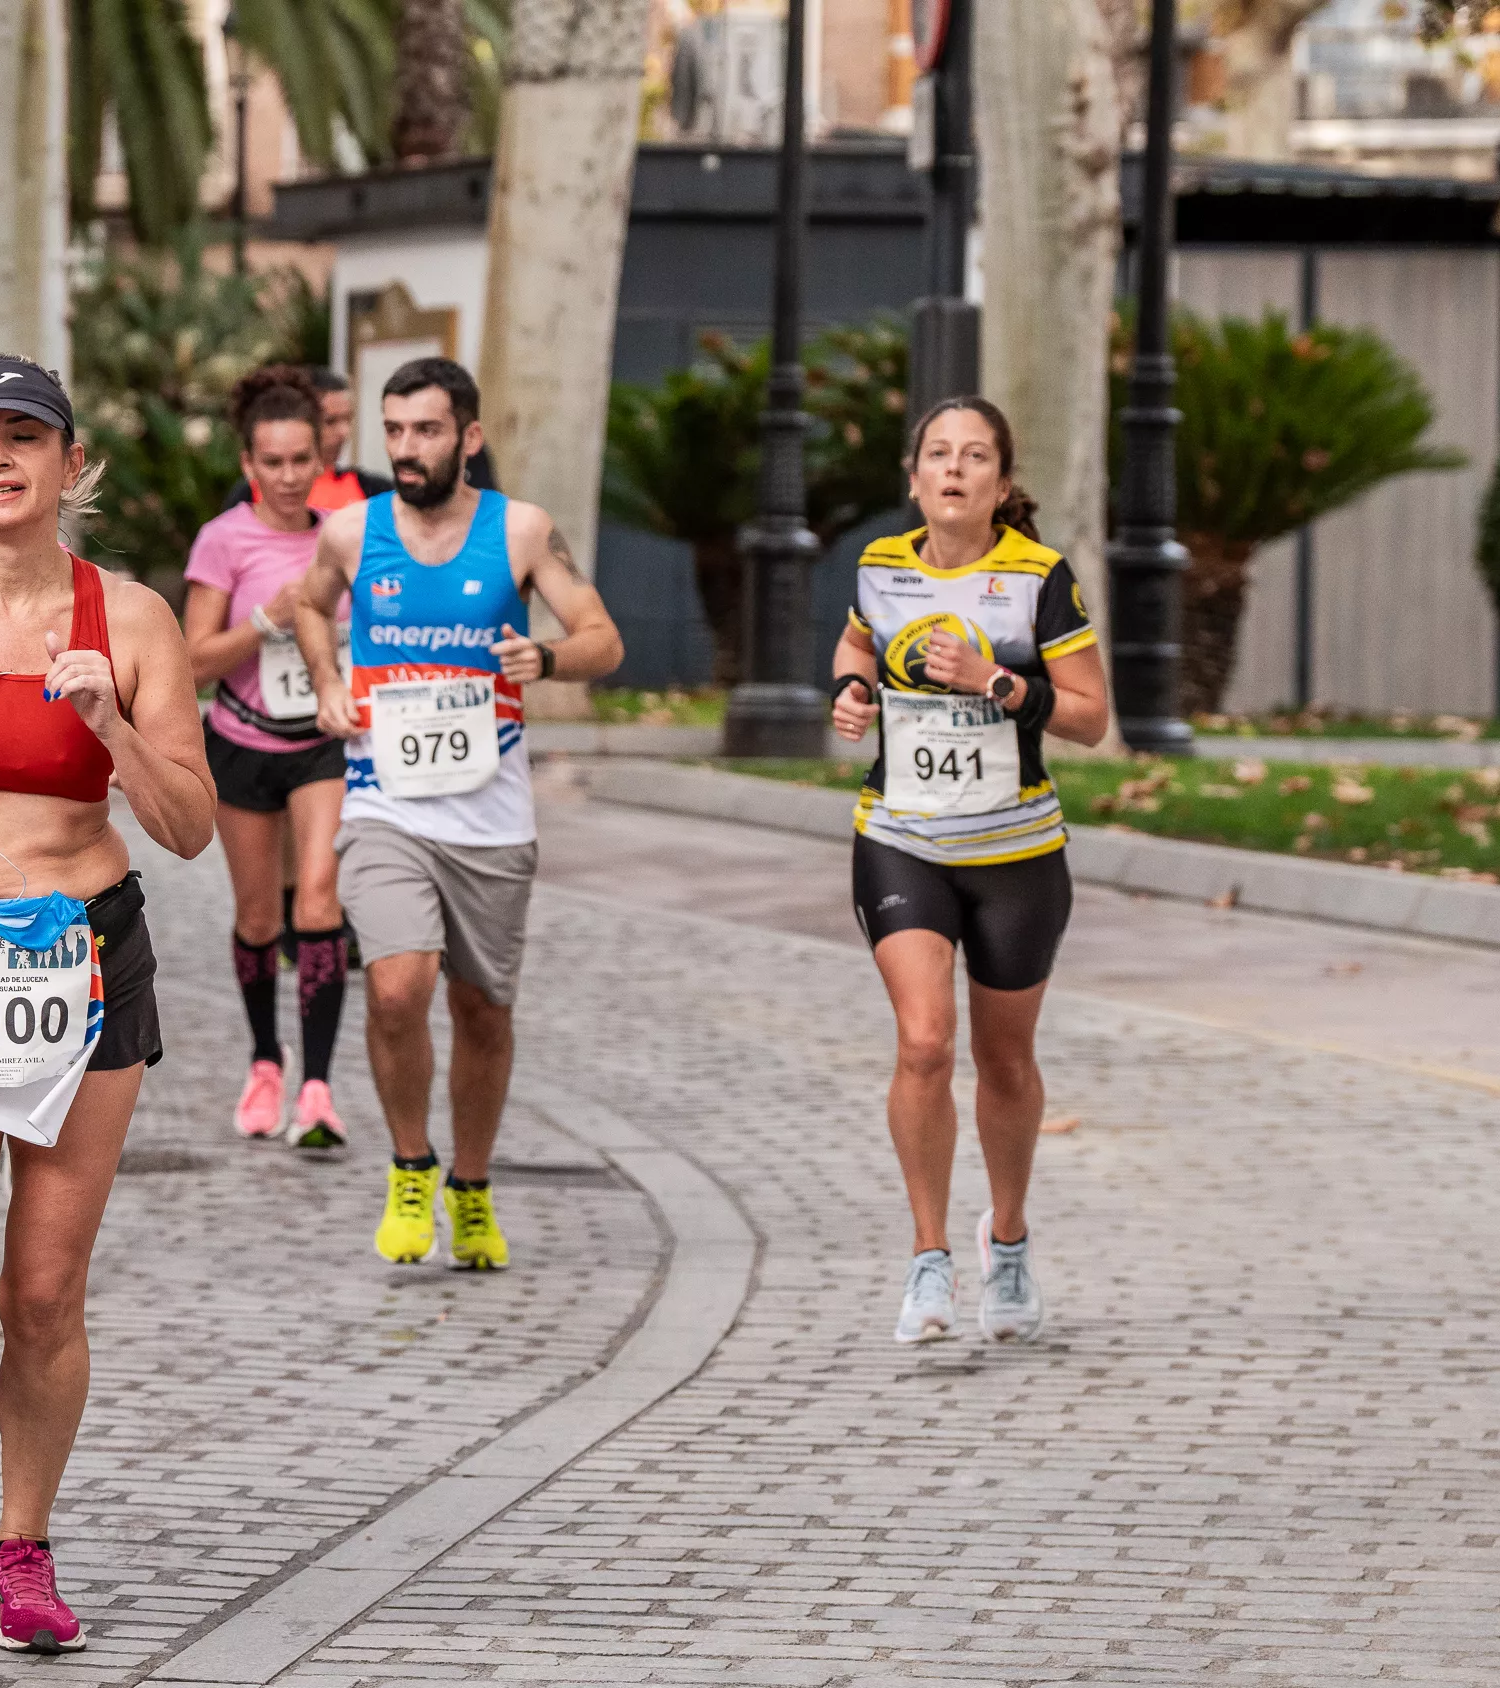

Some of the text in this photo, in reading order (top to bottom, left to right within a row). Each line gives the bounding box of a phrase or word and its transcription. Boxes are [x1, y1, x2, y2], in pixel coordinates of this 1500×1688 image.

[369, 623, 497, 652] enerplus
[401, 729, 469, 766] 979
[914, 747, 983, 781] 941
